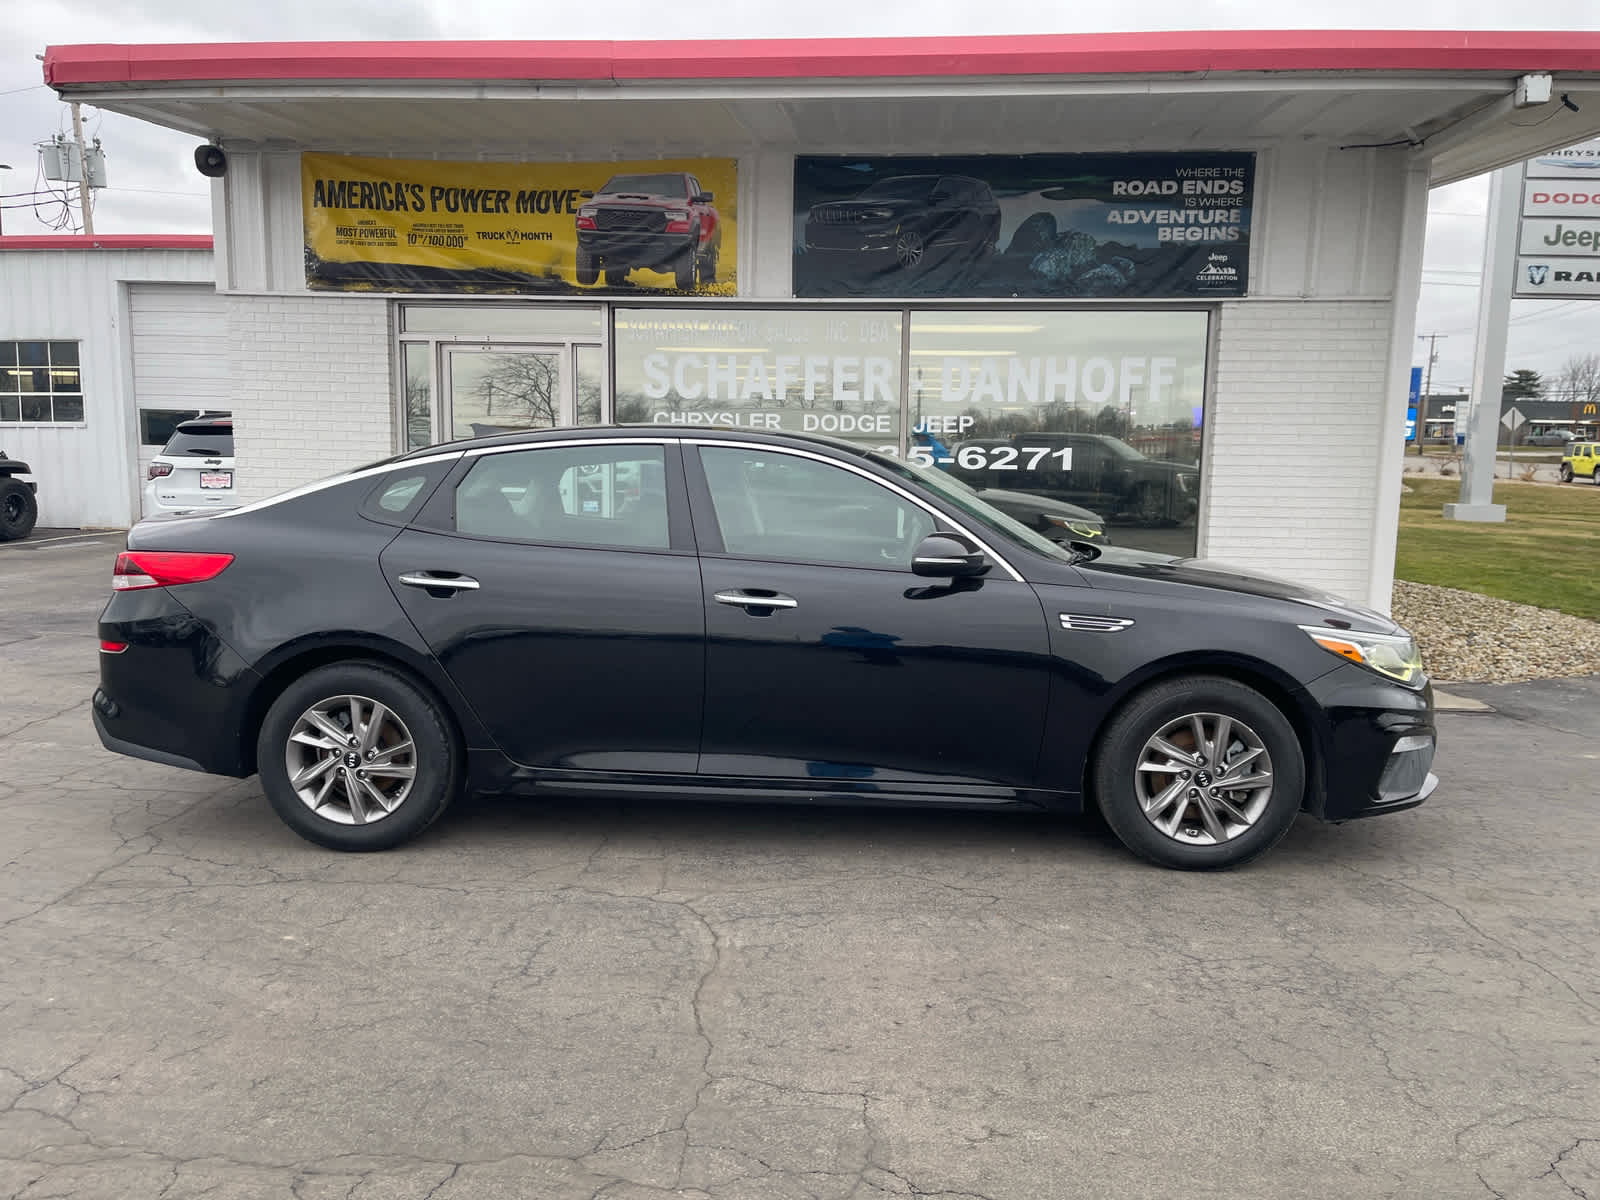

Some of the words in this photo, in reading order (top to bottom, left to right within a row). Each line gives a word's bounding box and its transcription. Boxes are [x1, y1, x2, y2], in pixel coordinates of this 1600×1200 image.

[1176, 168, 1220, 177] WHERE
[1224, 168, 1245, 177] THE
[1112, 180, 1178, 195] ROAD
[1182, 180, 1244, 195] ENDS
[313, 178, 425, 212] AMERICA'S
[430, 185, 509, 214] POWER
[1185, 198, 1197, 206] IS
[1199, 197, 1243, 206] WHERE
[1107, 209, 1241, 224] ADVENTURE
[336, 227, 358, 237] MOST
[359, 228, 397, 239] POWERFUL
[476, 231, 505, 240] TRUCK
[520, 232, 552, 240] MONTH
[1157, 226, 1240, 241] BEGINS
[1208, 252, 1229, 262] Jeep
[1554, 271, 1600, 282] RA
[642, 354, 895, 401] SCHAFFER
[941, 356, 1177, 402] DANHOFF
[653, 411, 782, 430] CHRYSLER
[803, 414, 892, 433] DODGE
[912, 415, 975, 433] JEEP
